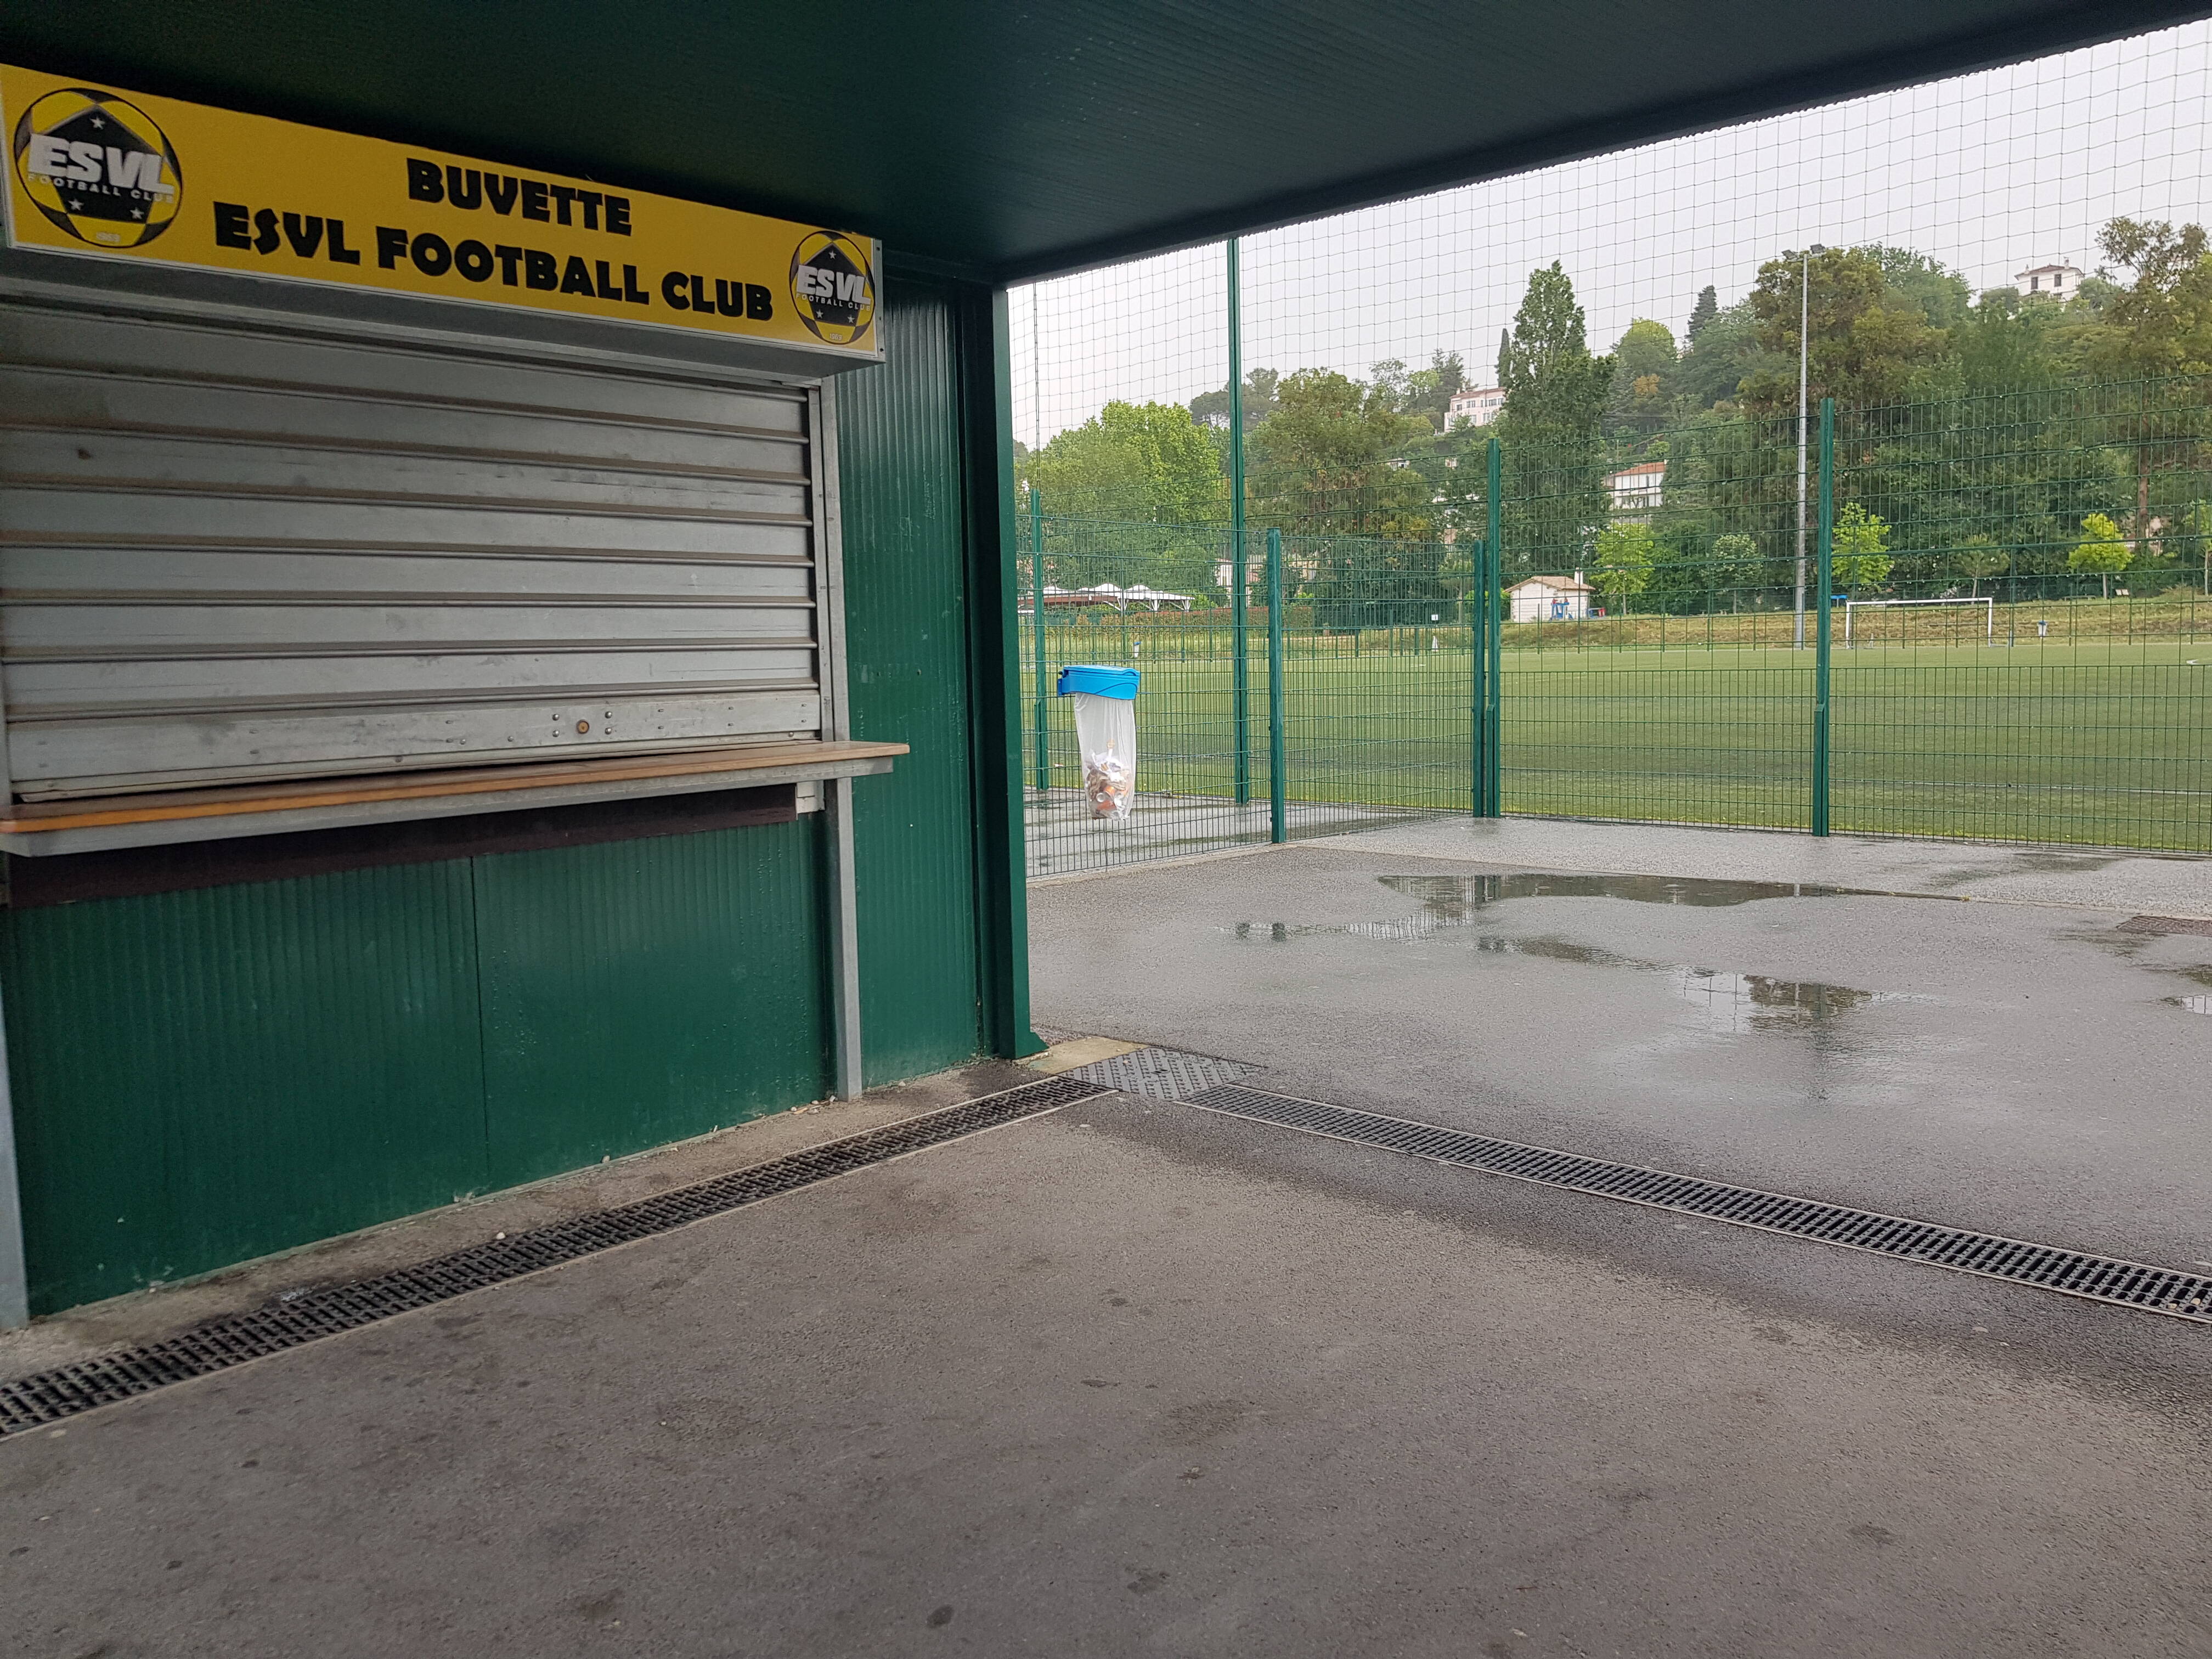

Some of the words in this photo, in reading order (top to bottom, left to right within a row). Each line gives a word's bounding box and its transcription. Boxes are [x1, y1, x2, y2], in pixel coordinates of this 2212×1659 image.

[29, 133, 174, 195] ESVL
[29, 173, 121, 196] FOOTBALL
[407, 157, 632, 236] BUVETTE
[213, 201, 360, 266] ESVL
[376, 225, 650, 305] FOOTBALL
[662, 271, 773, 321] CLUB
[797, 264, 871, 305] ESVL
[796, 293, 843, 307] FOOTBALL
[848, 302, 871, 312] CLUB
